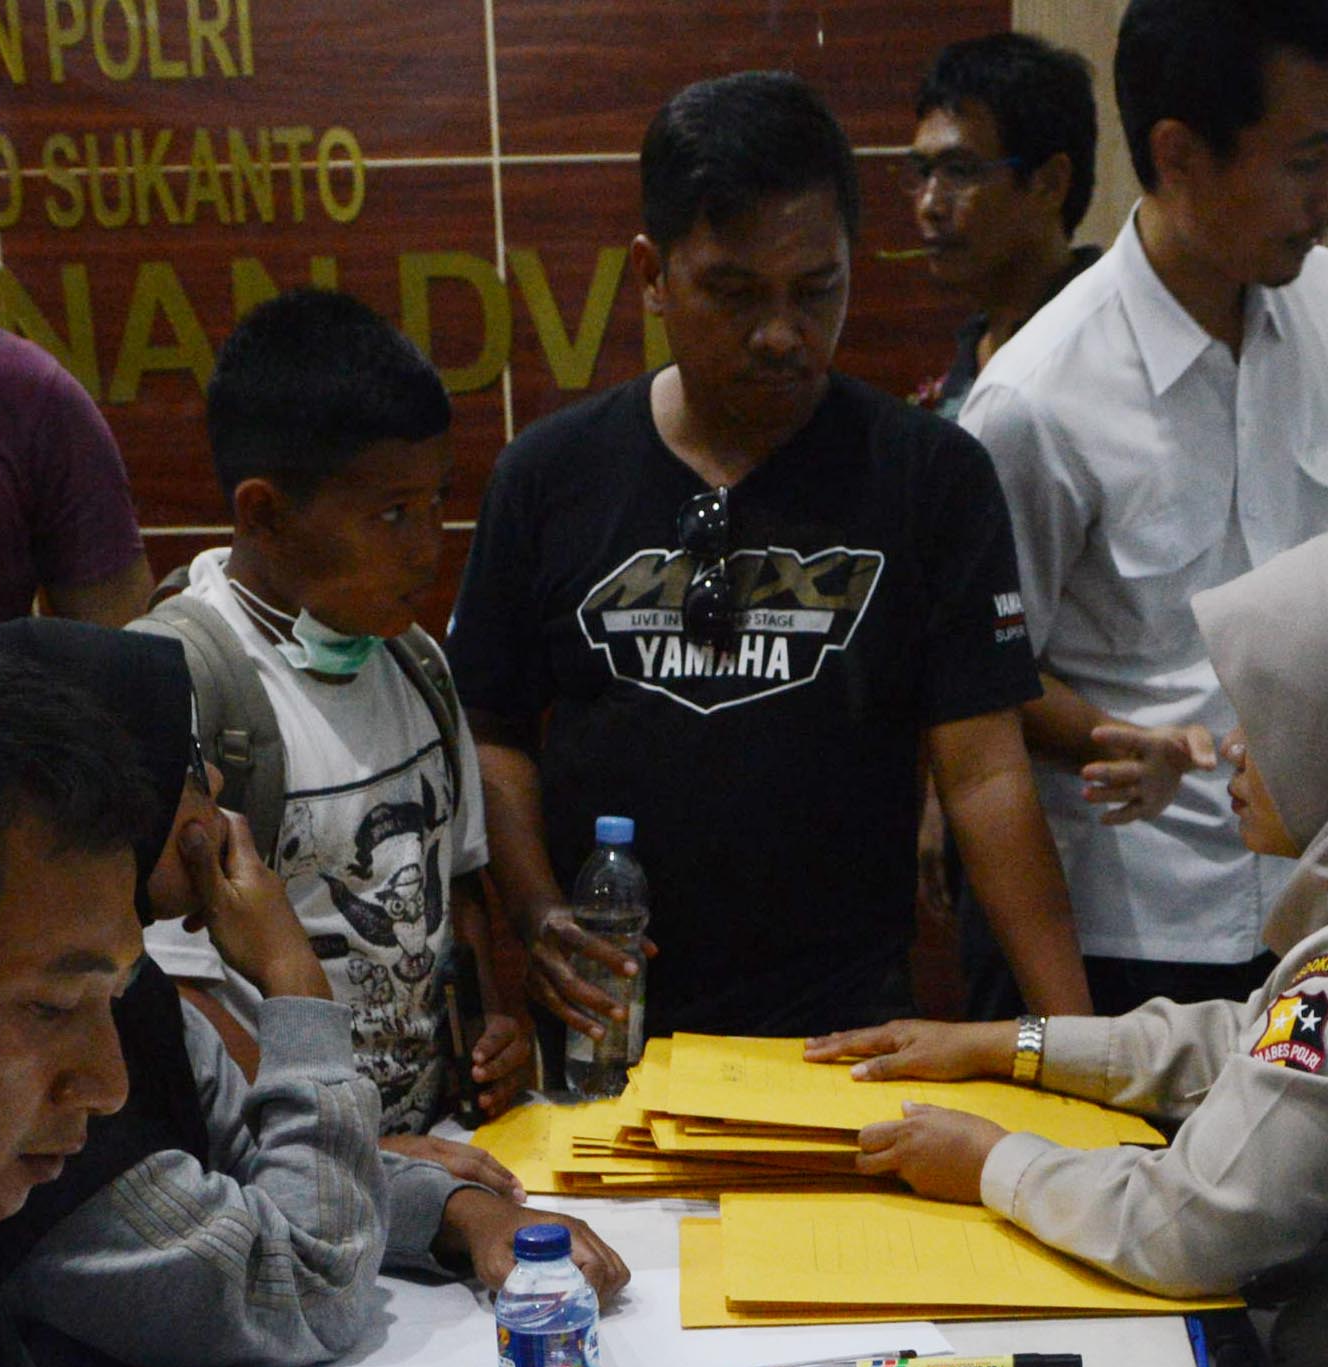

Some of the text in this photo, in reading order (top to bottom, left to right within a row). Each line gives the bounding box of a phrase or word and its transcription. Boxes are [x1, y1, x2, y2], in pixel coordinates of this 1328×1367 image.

[46, 0, 256, 84] POLRI
[42, 126, 365, 230] SUKANTO
[631, 613, 659, 627] LIVE
[754, 614, 795, 628] STAGE
[1254, 1042, 1322, 1070] MABES POLRI
